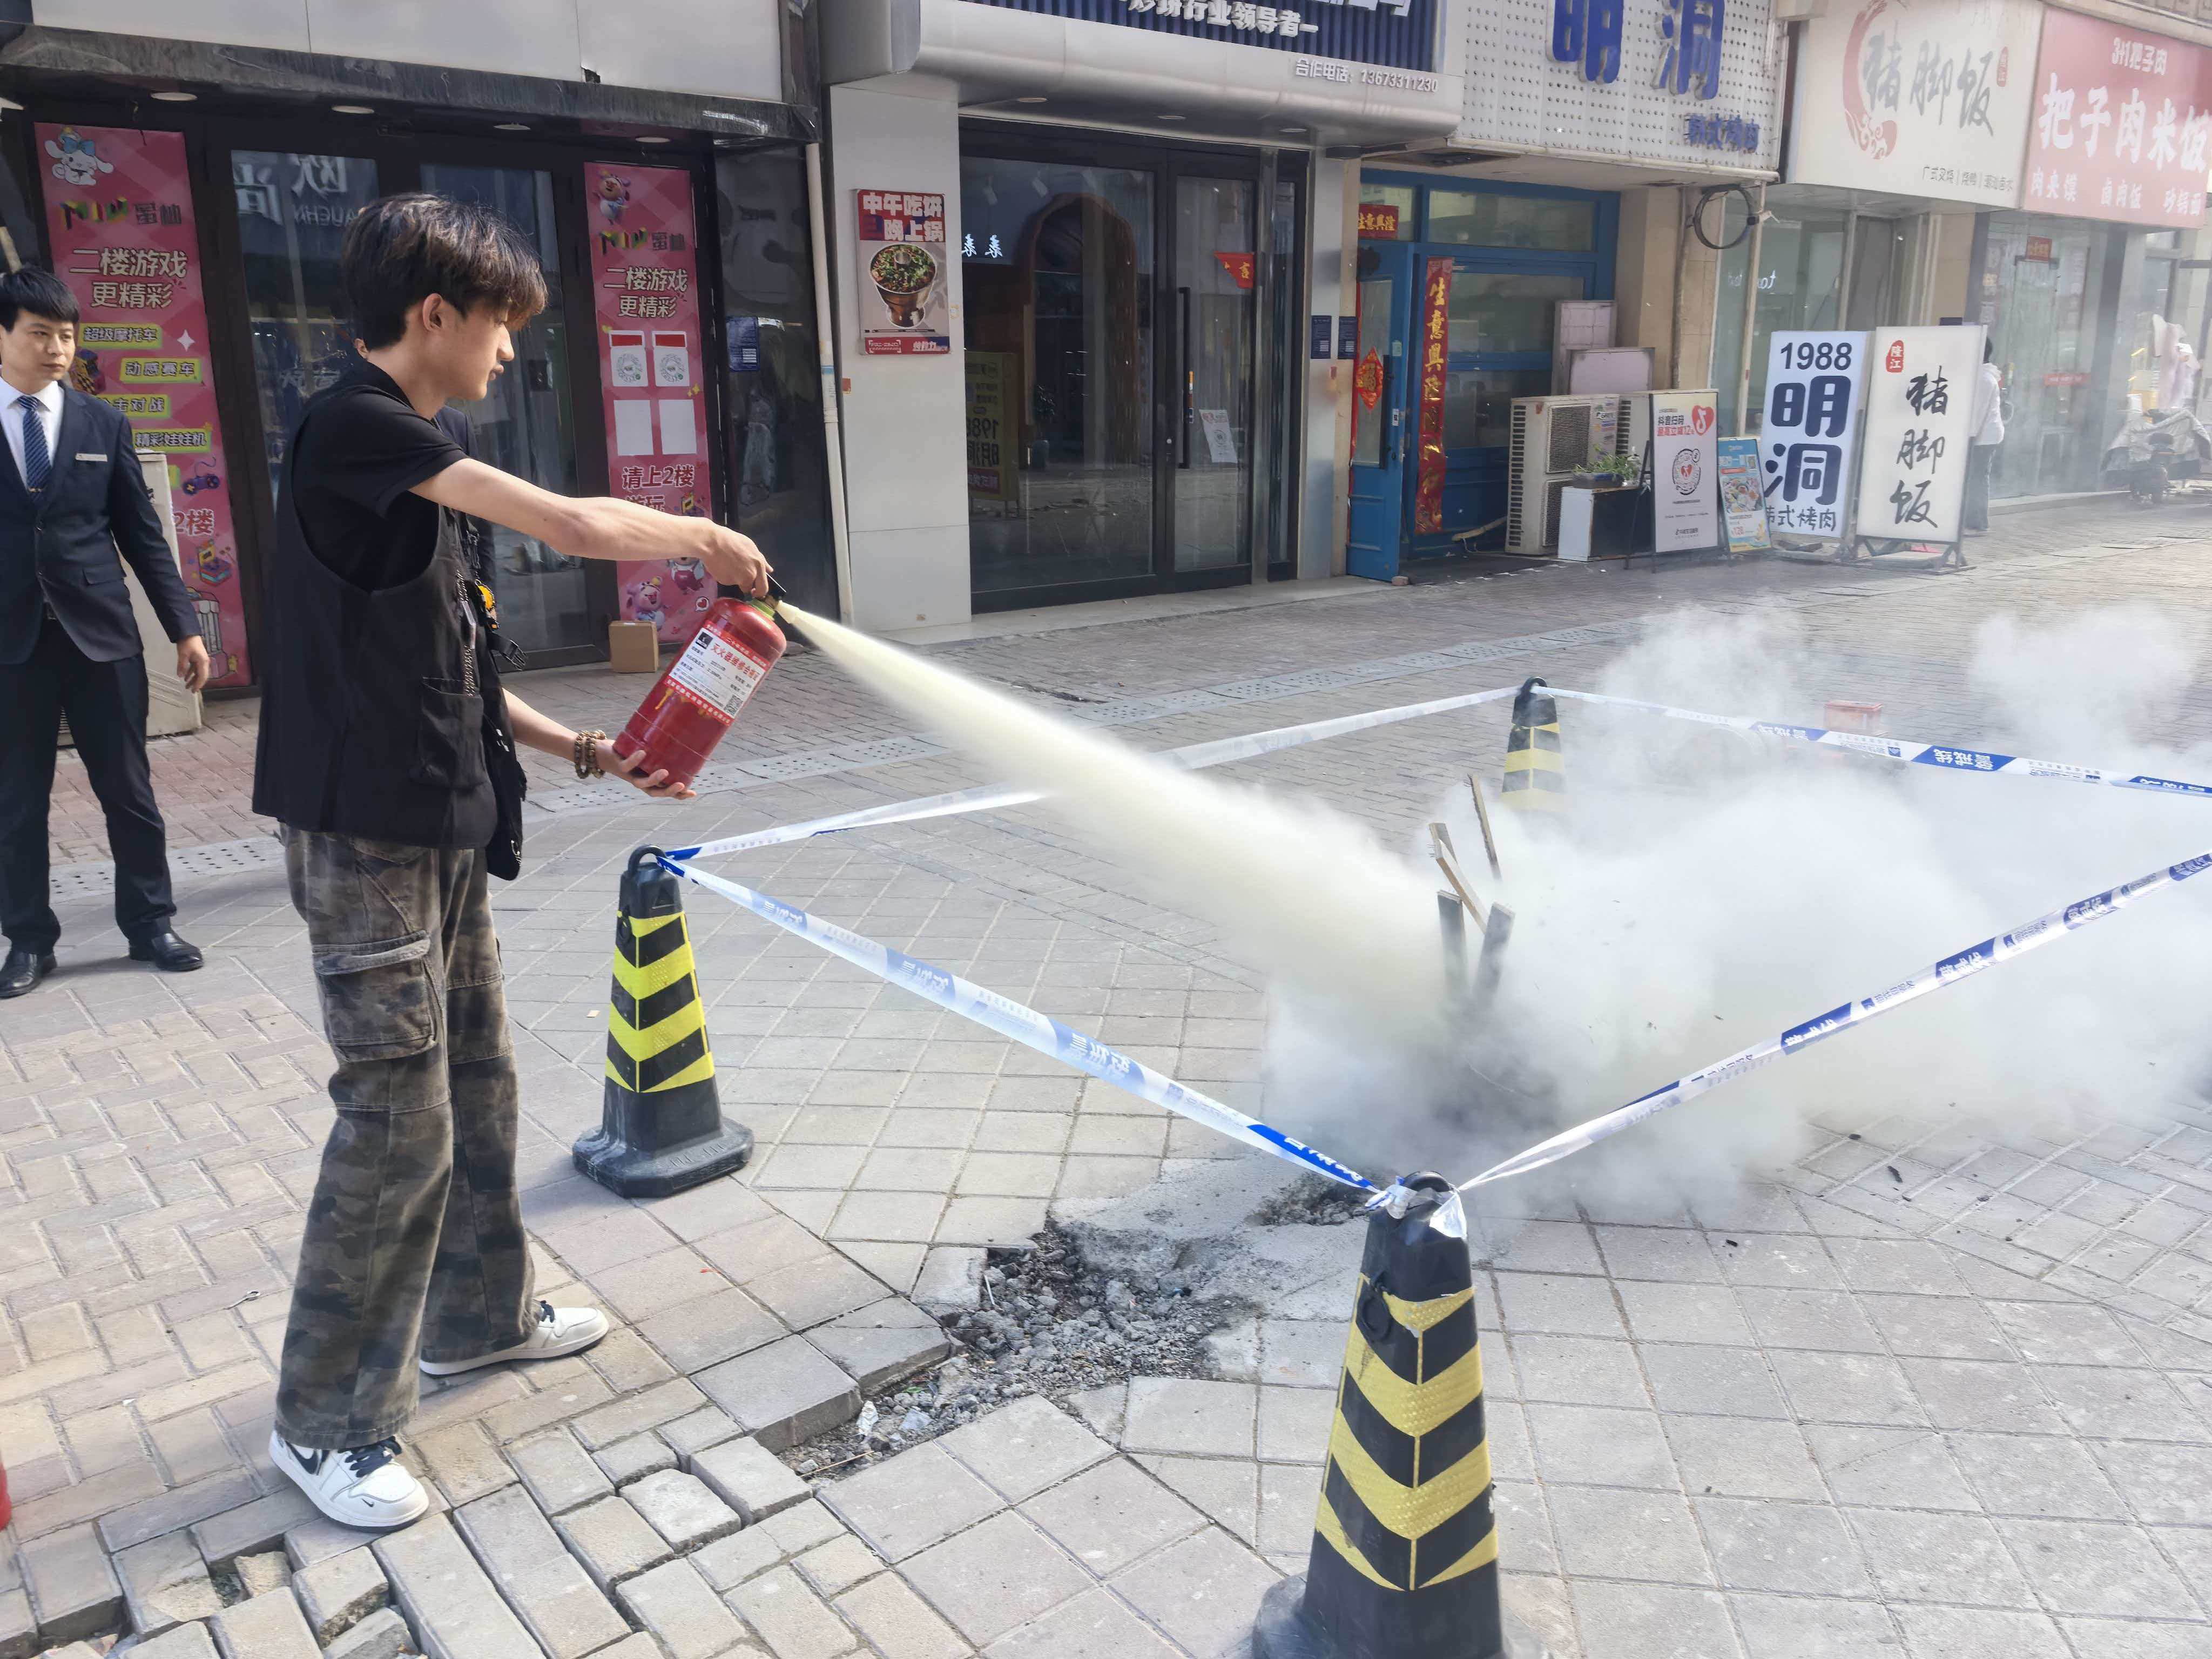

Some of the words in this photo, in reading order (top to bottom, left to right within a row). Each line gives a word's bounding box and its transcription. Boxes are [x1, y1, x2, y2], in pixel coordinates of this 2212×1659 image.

[1361, 69, 1439, 92] 13673311230
[1863, 21, 1994, 137] 猪脚饭
[69, 247, 187, 278] 二楼游戏
[604, 266, 687, 292] 二楼游戏
[91, 282, 173, 308] 更精彩
[618, 295, 676, 318] 更精彩
[83, 326, 157, 342] 超级摩托车
[125, 361, 194, 376] 动感赛车
[1781, 342, 1852, 370] 1988
[1764, 375, 1852, 505] 明洞
[1890, 366, 1951, 529] 猪脚饭
[622, 464, 694, 489] 请上2楼
